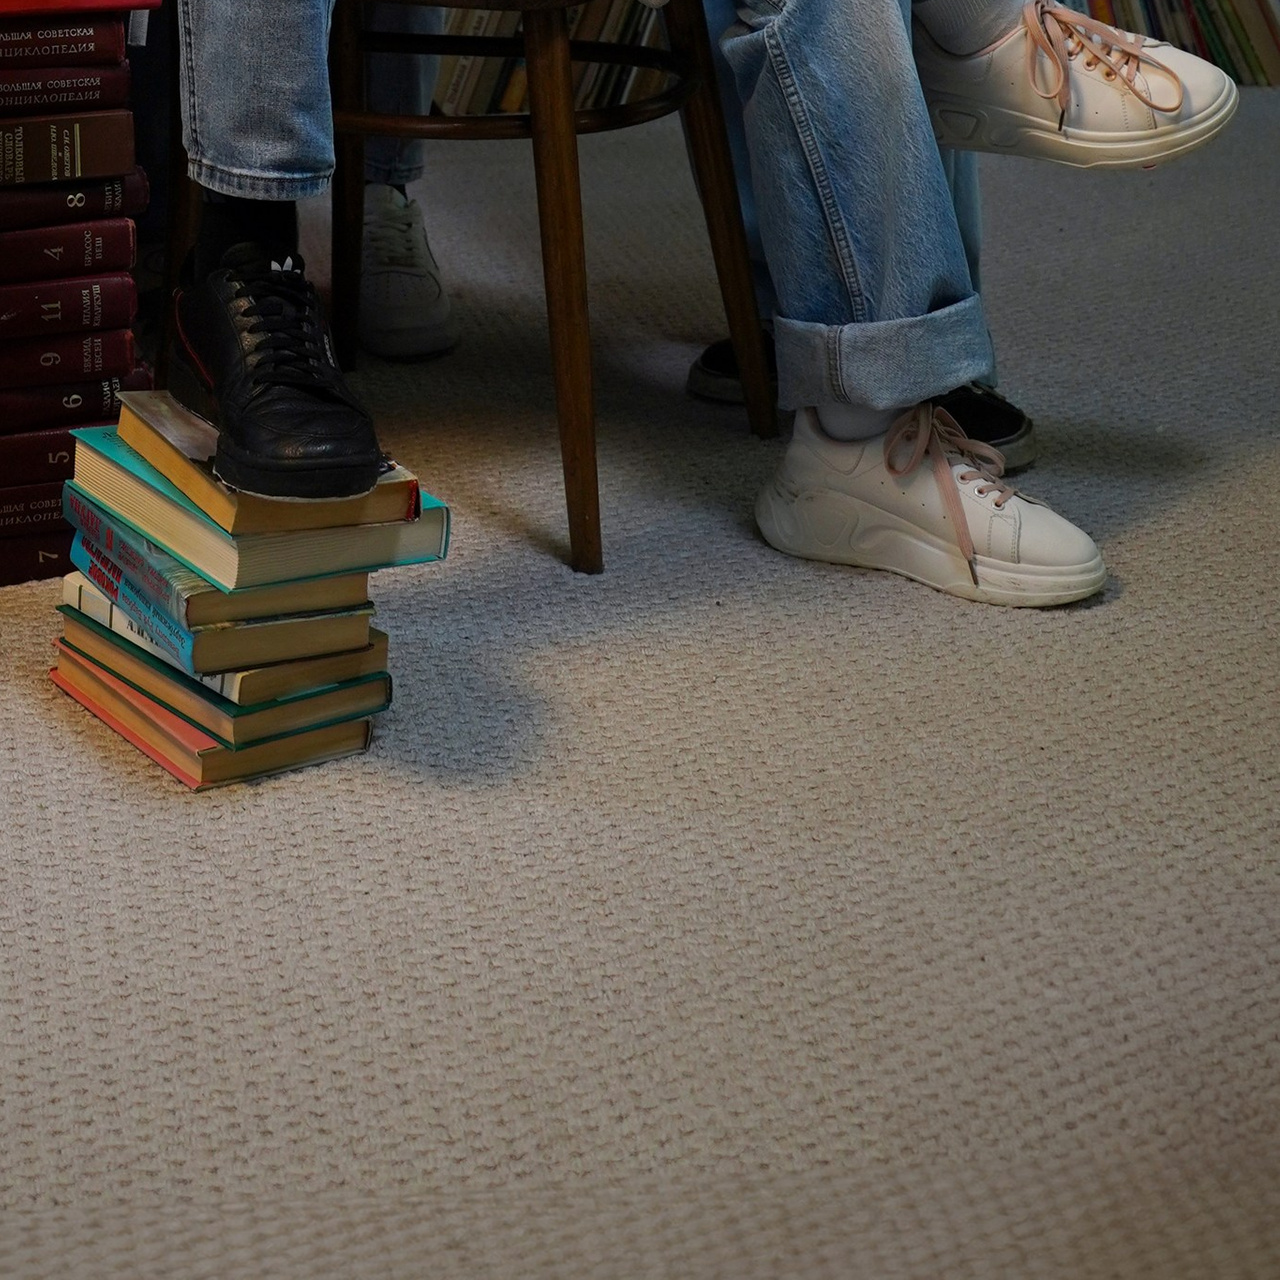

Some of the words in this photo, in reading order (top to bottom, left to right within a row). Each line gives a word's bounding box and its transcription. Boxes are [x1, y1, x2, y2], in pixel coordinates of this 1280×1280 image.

[36, 27, 95, 40] СОВЕТСКАЯ
[44, 77, 102, 90] СОВЕТСКАЯ
[4, 132, 14, 180] СЛОВАРЬ
[15, 126, 25, 183] ТОЛКОВЫЙ
[66, 192, 86, 209] 8
[43, 245, 64, 260] 4
[83, 230, 93, 267] БРАСОС
[40, 300, 62, 322] 11
[81, 288, 91, 326] ИТАЛИЯ
[39, 351, 62, 367] 9
[93, 338, 103, 373] ИБСЕН
[62, 393, 83, 410] 6
[47, 450, 70, 464] 5
[29, 498, 64, 511] СОВЕТ
[38, 549, 60, 563] 7
